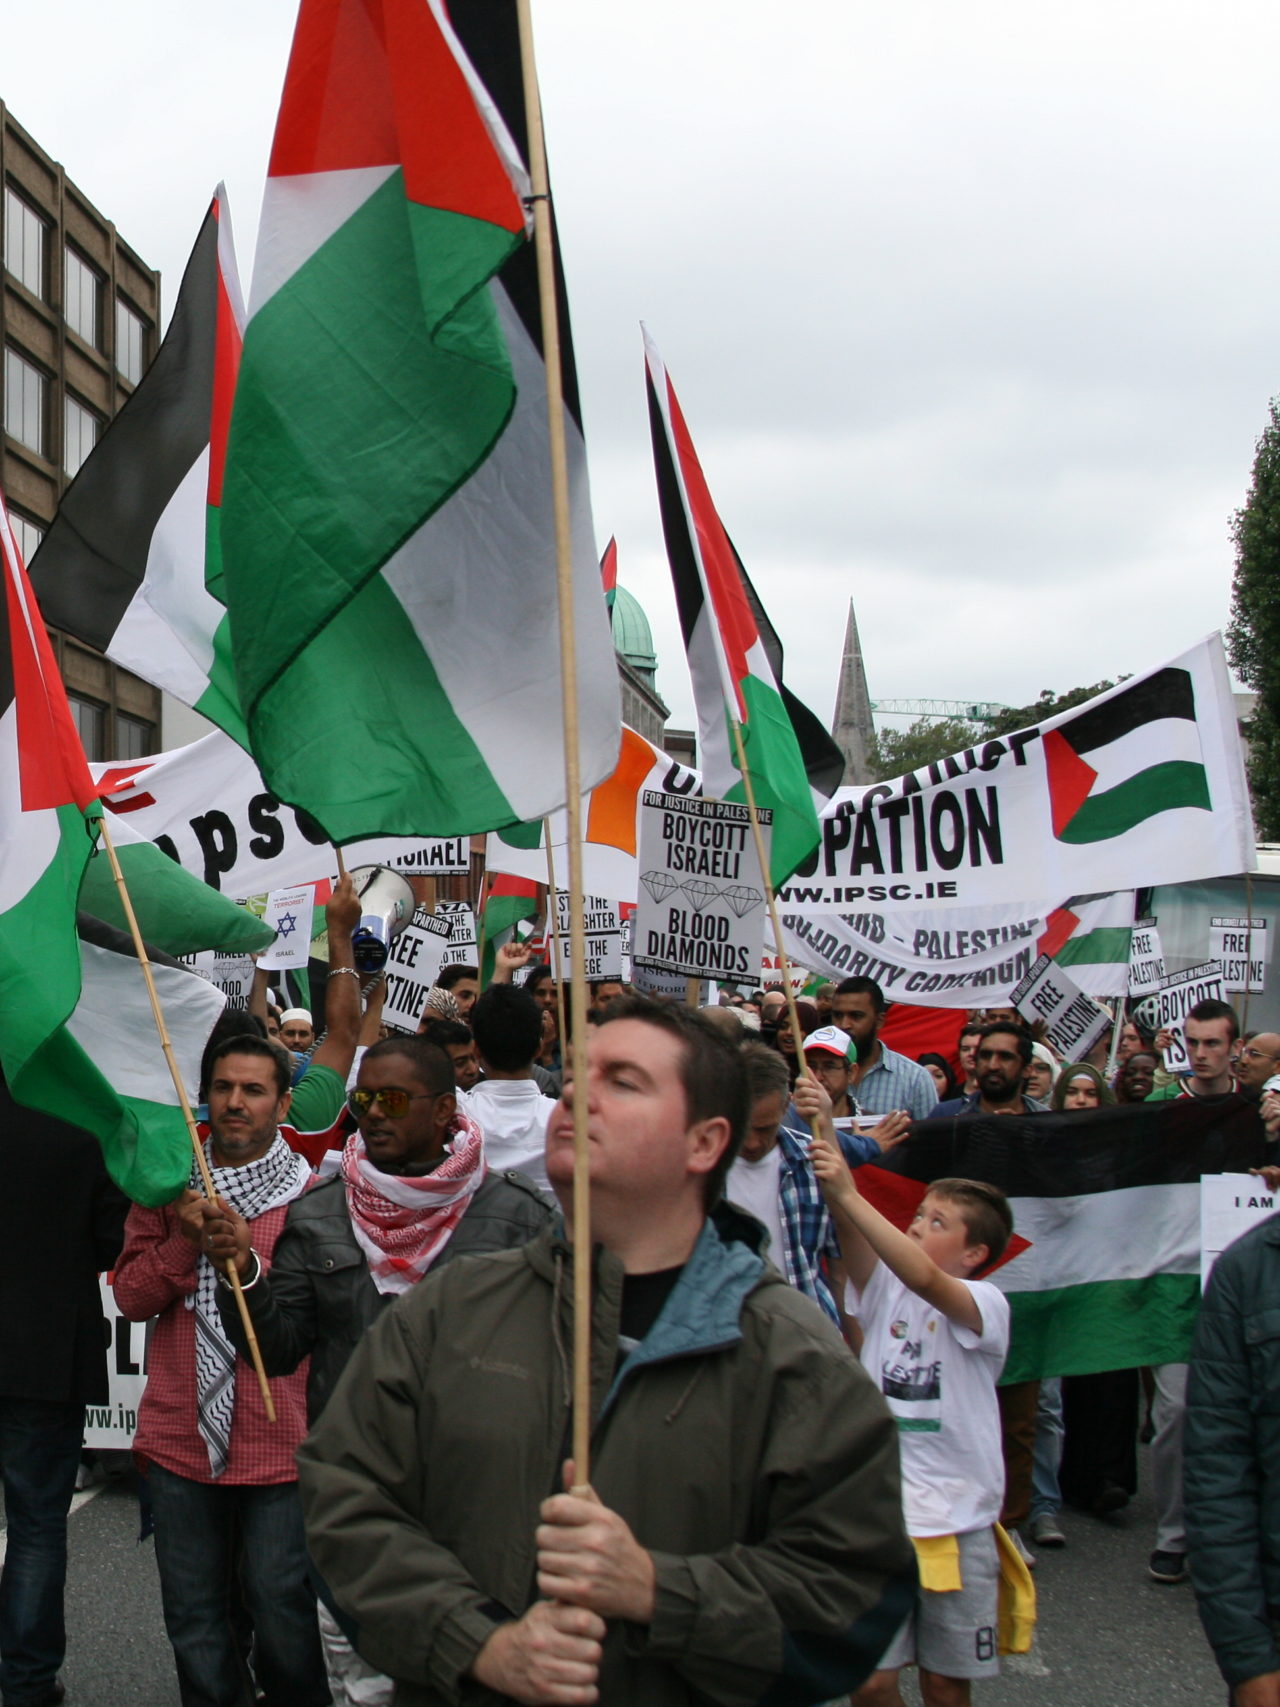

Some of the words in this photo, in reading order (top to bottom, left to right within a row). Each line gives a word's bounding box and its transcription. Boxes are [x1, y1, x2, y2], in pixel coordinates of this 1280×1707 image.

[644, 791, 663, 807] FOR
[664, 794, 701, 815] JUSTICE
[703, 803, 715, 816] IN
[716, 804, 772, 823] PALESNE
[663, 813, 750, 852] BOYCOTT
[666, 843, 740, 880] ISRAELI
[434, 902, 471, 914] AZA
[774, 881, 958, 903] WW.IPSC.IE
[451, 914, 466, 926] THE
[669, 907, 730, 943] BLOOD
[276, 949, 295, 958] ISRAEL
[389, 935, 424, 968] REE
[451, 950, 468, 963] THE
[588, 940, 608, 957] THE
[648, 931, 750, 973] DIAMONDS
[1132, 934, 1153, 956] FREE
[1030, 979, 1065, 1019] FREE
[1161, 979, 1222, 1023] BOYCOTT
[1044, 992, 1102, 1056] PALESTINE
[1235, 1196, 1240, 1208] I
[1247, 1196, 1274, 1208] AM
